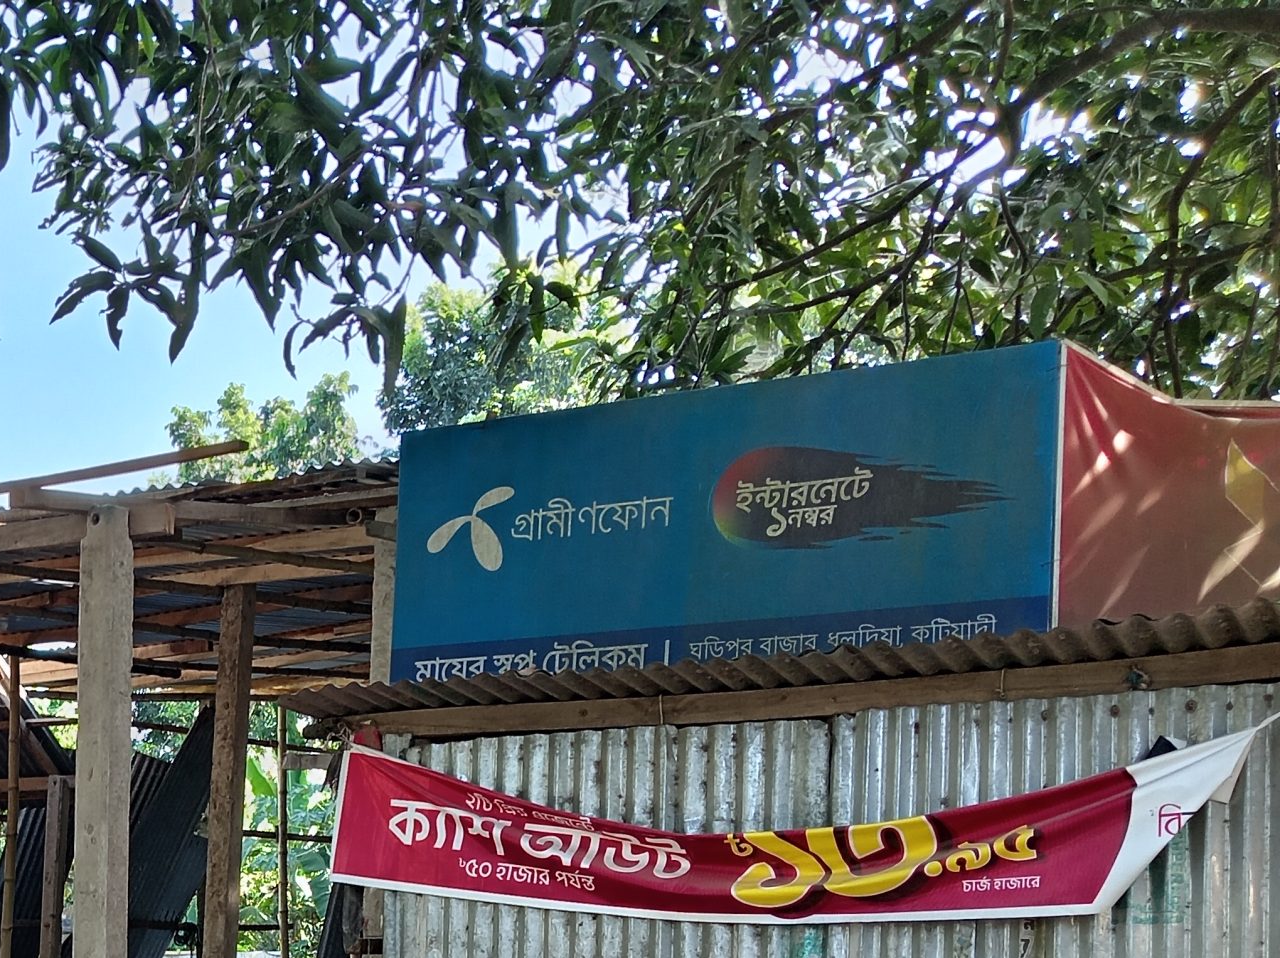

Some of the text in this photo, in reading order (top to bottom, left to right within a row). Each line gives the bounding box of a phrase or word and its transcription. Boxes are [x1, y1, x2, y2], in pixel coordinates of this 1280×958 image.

[735, 466, 874, 513] ইন্টারনেটে
[511, 496, 674, 541] গ্রামীণফোন
[388, 798, 692, 880] ক্যাশ আউট
[496, 862, 551, 886] হাজার
[555, 869, 596, 892] পর্যন্ত
[961, 875, 1041, 893] চার্জ হাজারে
